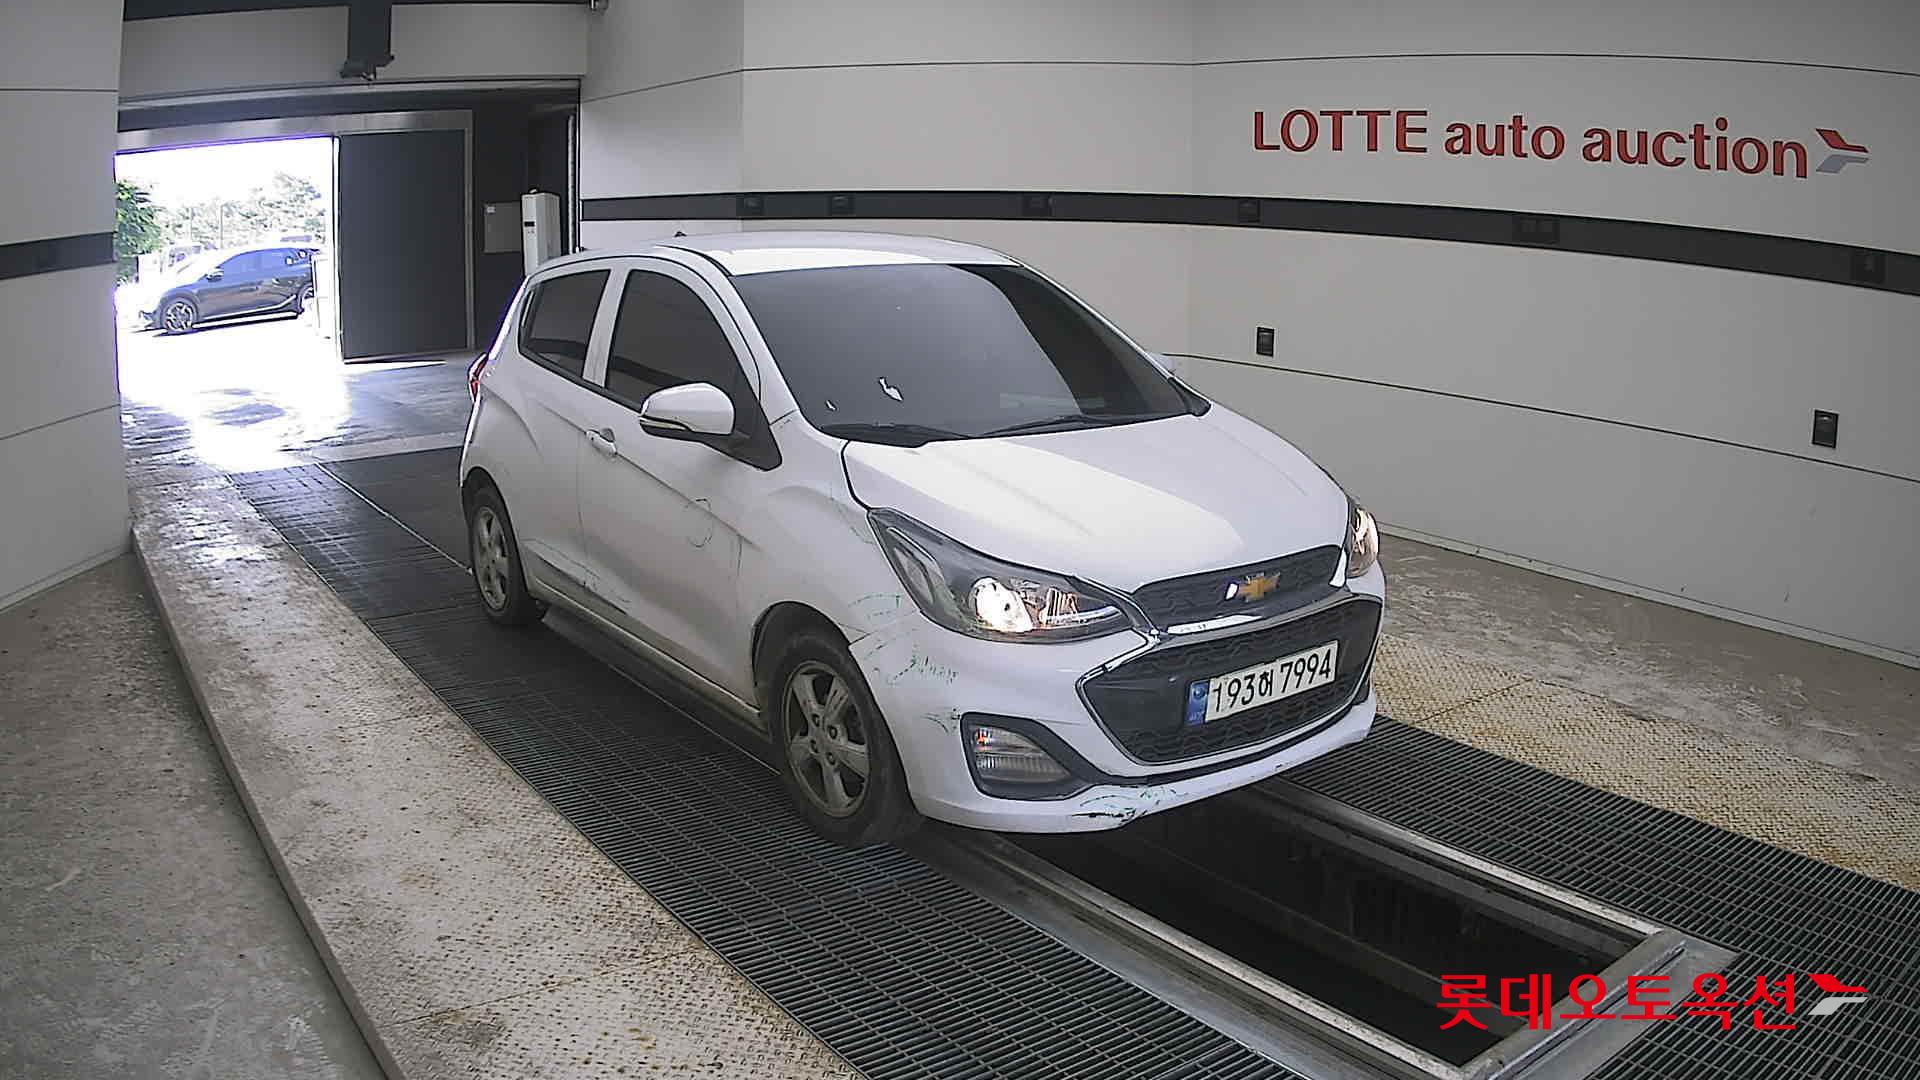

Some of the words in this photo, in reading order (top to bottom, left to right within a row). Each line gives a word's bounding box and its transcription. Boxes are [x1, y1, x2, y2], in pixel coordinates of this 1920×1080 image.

[1254, 109, 1428, 153] LOTTE
[1444, 114, 1566, 160] auto
[1582, 116, 1808, 179] auction
[1212, 669, 1274, 713] 193허
[1280, 648, 1332, 693] 7994
